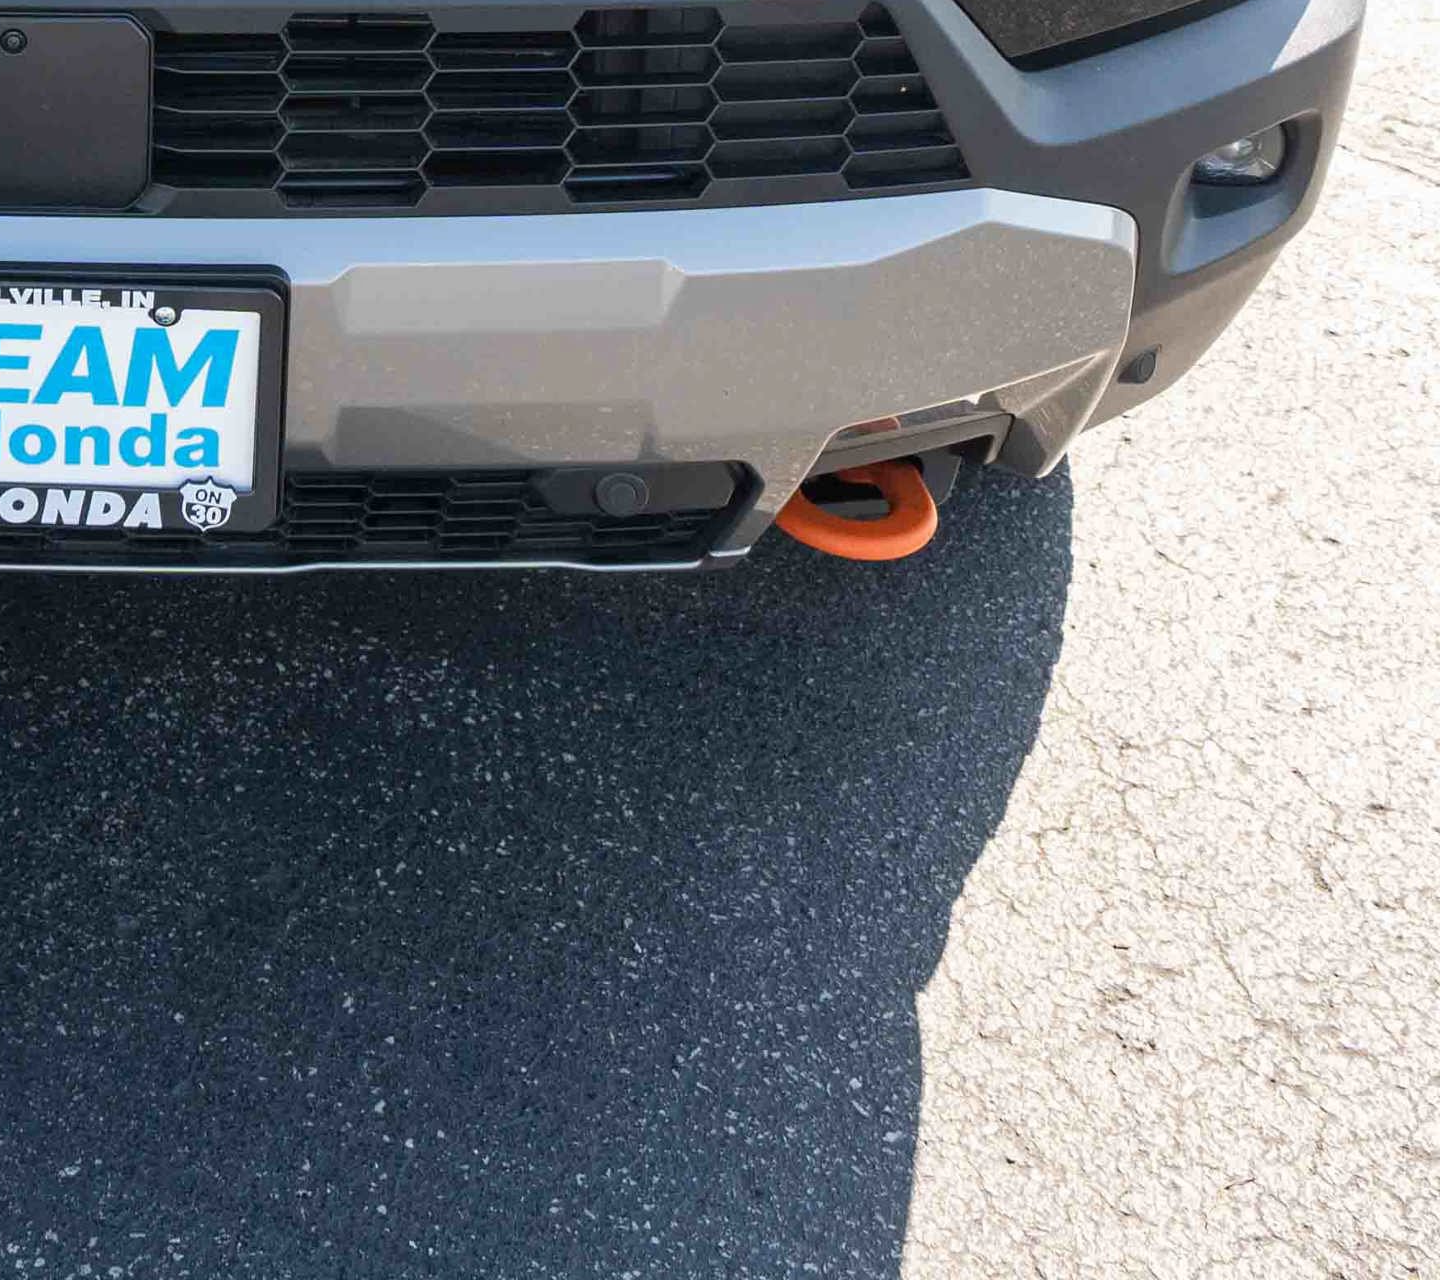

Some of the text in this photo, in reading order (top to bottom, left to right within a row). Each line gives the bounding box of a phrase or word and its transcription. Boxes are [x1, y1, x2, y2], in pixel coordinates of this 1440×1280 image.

[121, 290, 155, 310] IN
[195, 489, 221, 504] ON
[190, 504, 222, 525] 30
